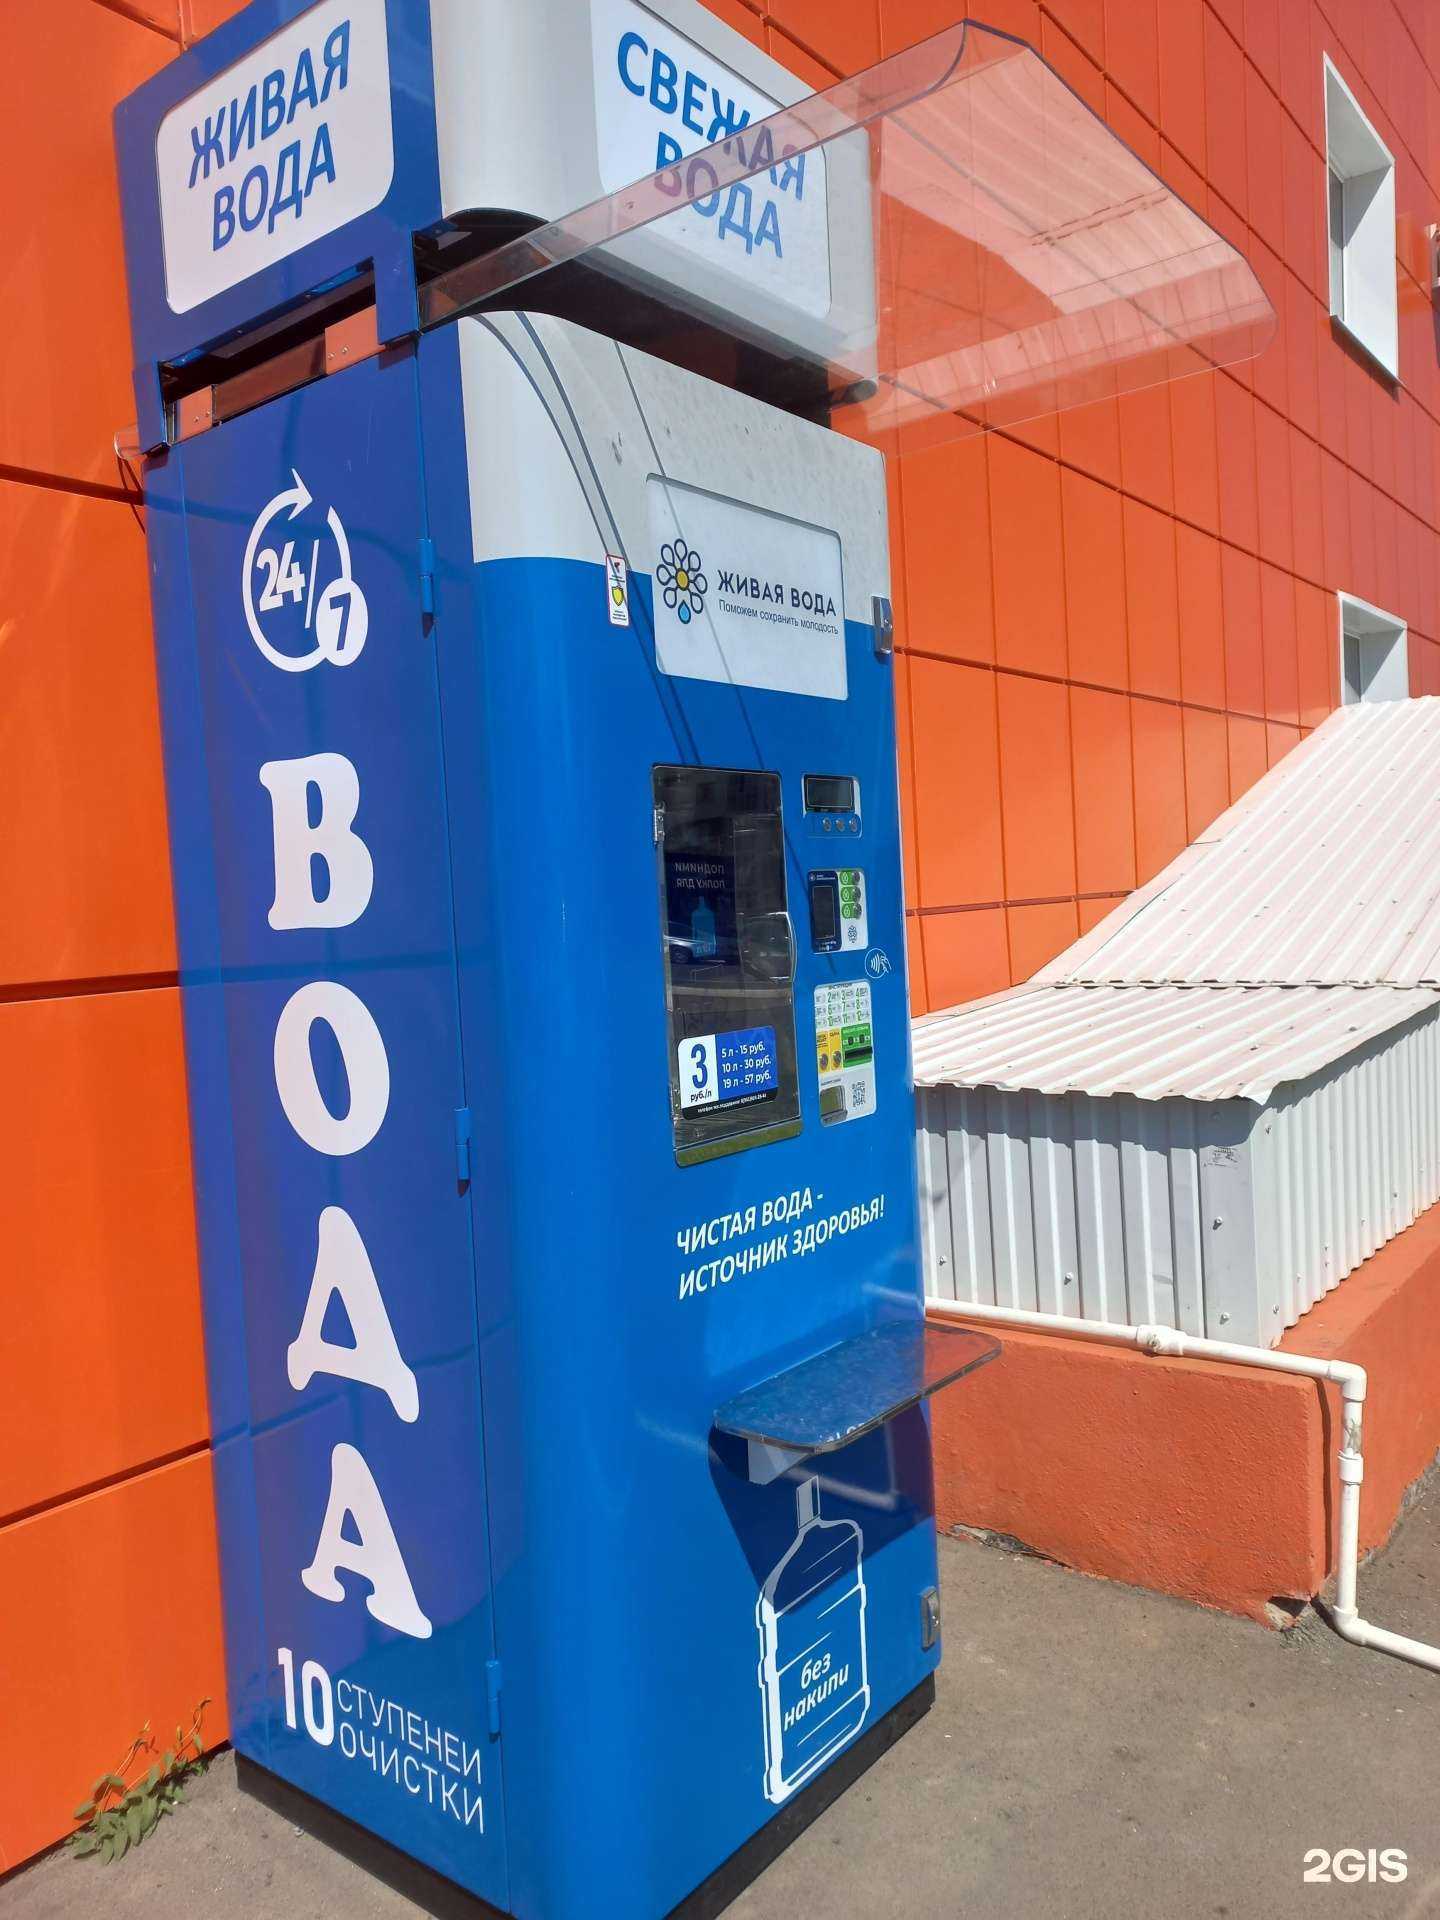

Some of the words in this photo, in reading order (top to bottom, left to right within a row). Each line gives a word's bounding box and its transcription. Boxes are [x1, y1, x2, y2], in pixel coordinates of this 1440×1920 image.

[188, 19, 351, 190] ЖИВАЯ
[617, 31, 806, 201] СВЕЖАЯ
[212, 121, 337, 253] ВОДА
[653, 131, 783, 259] ВОДА
[256, 538, 352, 652] 24/7
[716, 569, 784, 605] ЖИВАЯ
[790, 587, 837, 617] ВОДА
[718, 599, 758, 618] Поможем
[759, 609, 800, 628] сохранить
[800, 617, 839, 635] молодость
[691, 1043, 708, 1088] 3
[721, 1048, 727, 1058] 5
[728, 1048, 734, 1057] л
[740, 1044, 748, 1055] 15
[749, 1040, 766, 1055] руб.
[722, 1063, 731, 1073] 10
[732, 1063, 738, 1072] л
[744, 1058, 755, 1069] 30
[756, 1054, 772, 1069] руб.
[722, 1077, 732, 1089] 19
[733, 1077, 739, 1087] л
[744, 1073, 755, 1085] 57
[756, 1069, 772, 1084] руб.
[690, 1091, 712, 1103] руб./л
[258, 751, 434, 1640] ВОДА
[676, 1206, 757, 1255] ЧИСТАЯ
[760, 1186, 814, 1224] ВОДА
[678, 1234, 789, 1300] ИСТОЧНИК
[791, 1193, 885, 1257] ЗДОРОВЬЯ!
[277, 1646, 335, 1747] 10
[783, 1662, 850, 1732] накипи
[800, 1651, 832, 1690] без
[339, 1721, 484, 1835] ОЧИСТКИ
